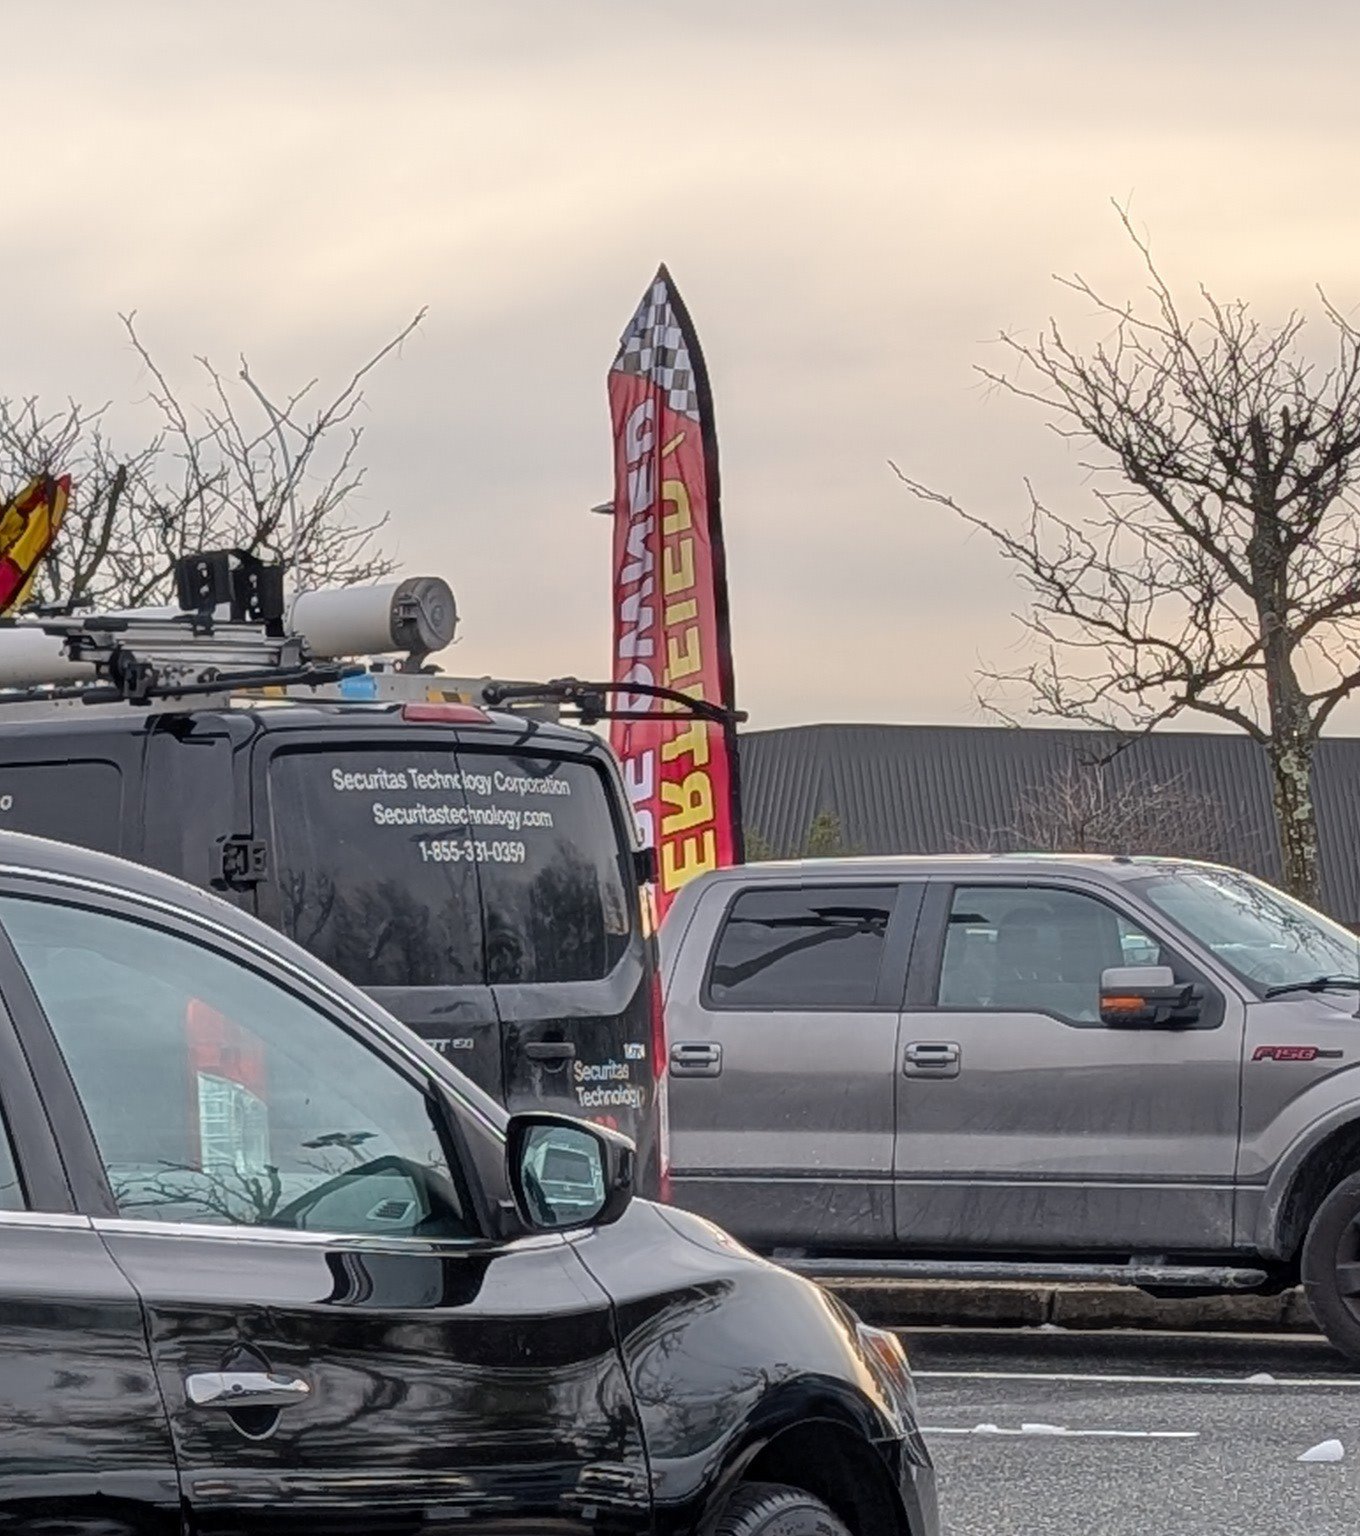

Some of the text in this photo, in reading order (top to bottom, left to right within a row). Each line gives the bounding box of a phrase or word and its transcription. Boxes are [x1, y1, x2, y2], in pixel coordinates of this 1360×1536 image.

[331, 768, 571, 797] Securitas Technology Corporation
[372, 803, 553, 830] Securitastechnology.com
[573, 1059, 629, 1082] Securitas
[575, 1086, 641, 1109] Technology
